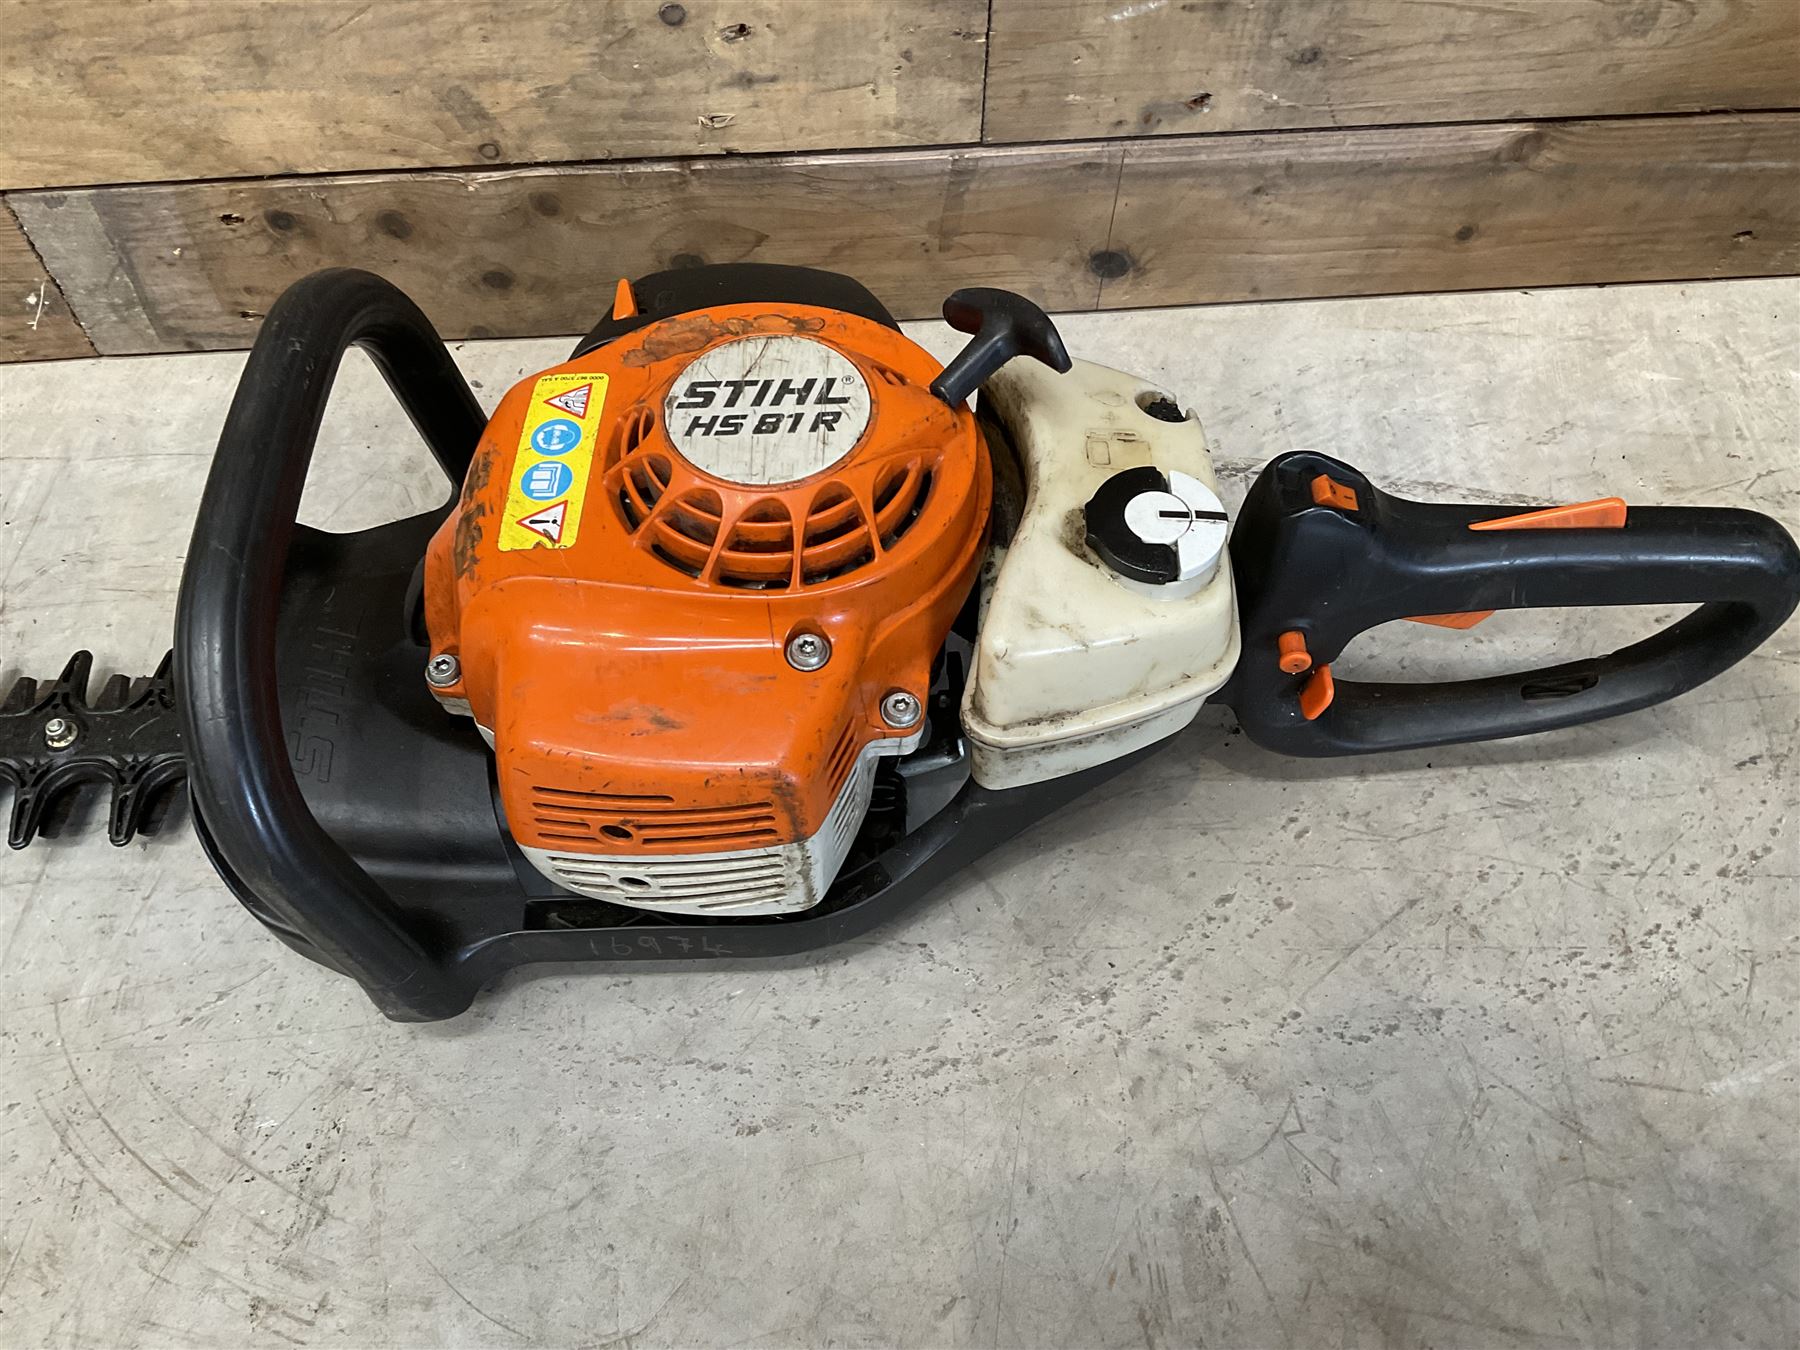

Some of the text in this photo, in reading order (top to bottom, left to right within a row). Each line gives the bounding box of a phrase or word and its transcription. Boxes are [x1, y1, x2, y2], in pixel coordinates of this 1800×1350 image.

[675, 377, 851, 409] STIHL
[684, 411, 842, 436] HS 81 R
[589, 935, 735, 957] 16974
